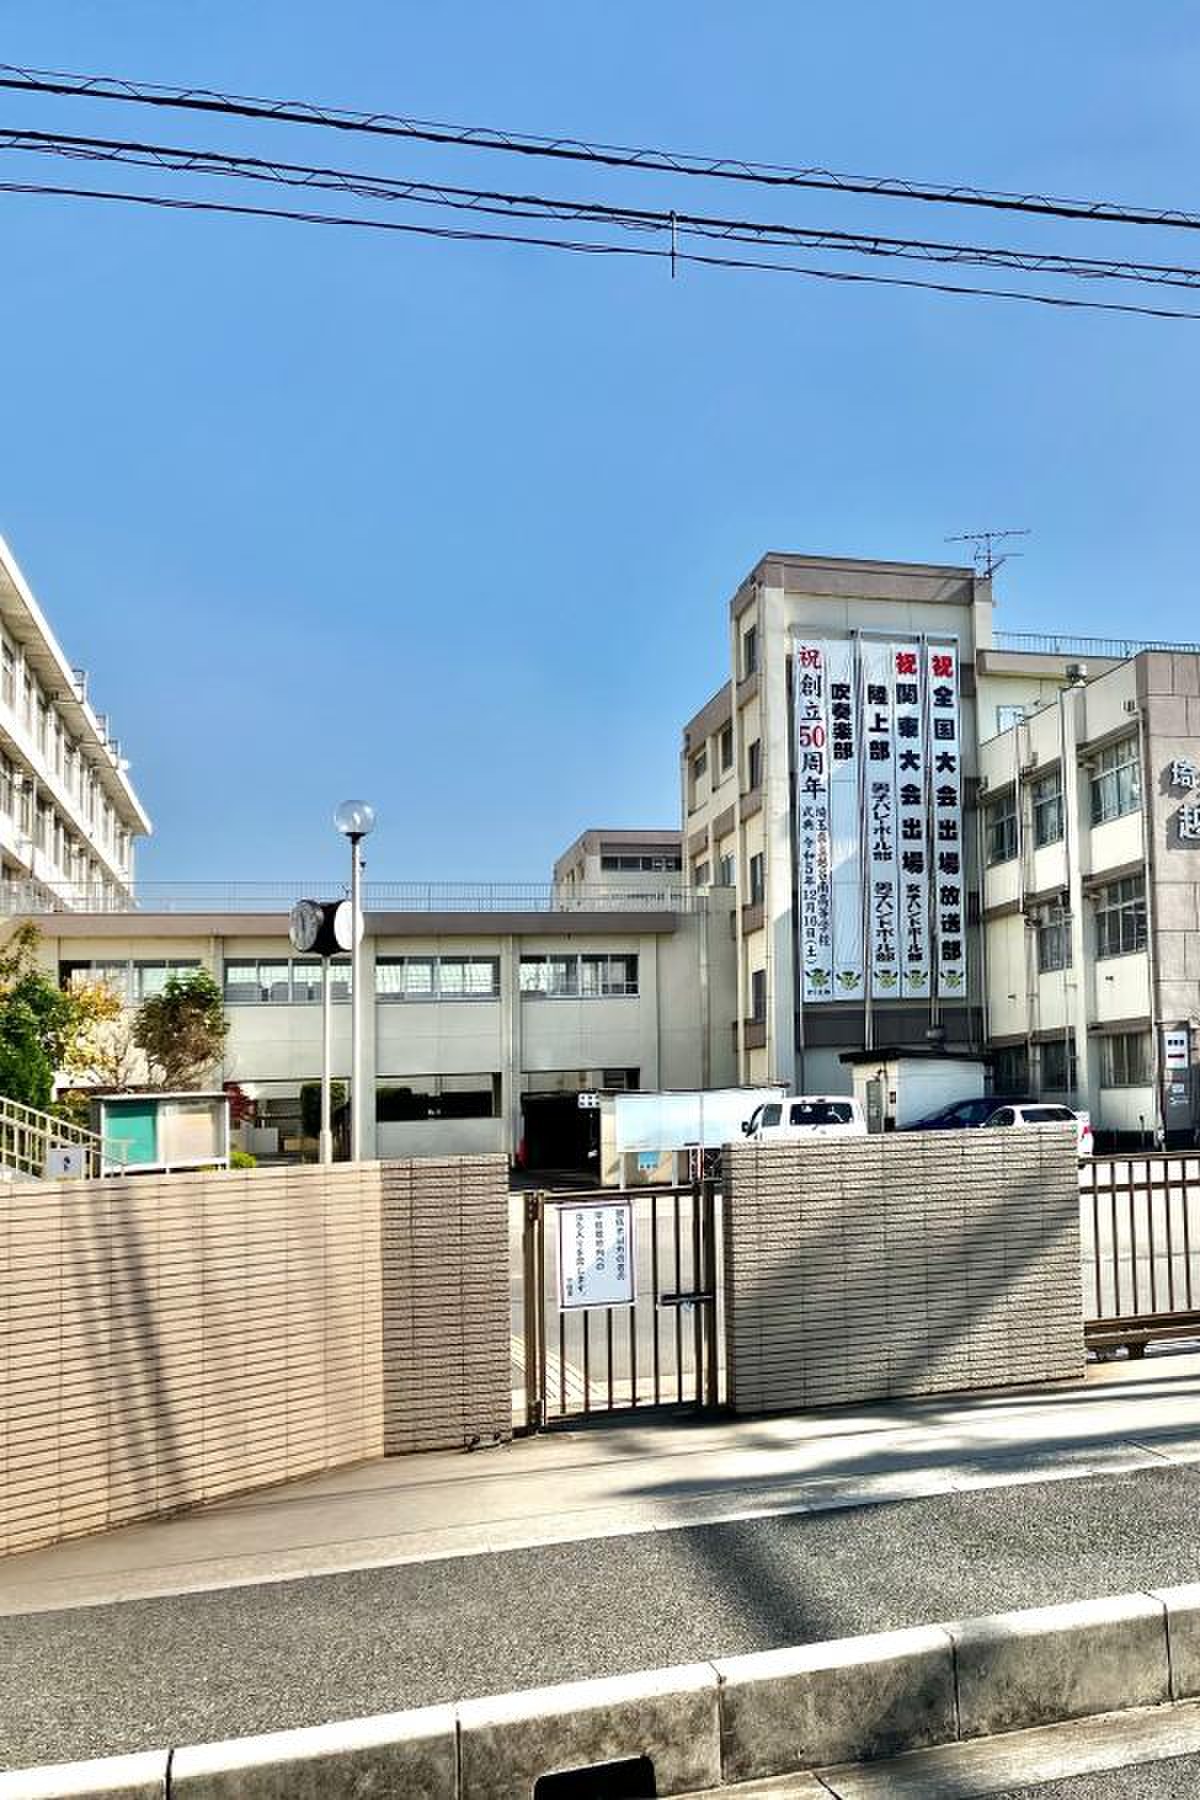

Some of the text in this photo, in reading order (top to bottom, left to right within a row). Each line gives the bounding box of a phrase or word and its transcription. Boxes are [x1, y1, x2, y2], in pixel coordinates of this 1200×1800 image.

[831, 683, 853, 760] 吹奏楽部
[867, 684, 890, 761] 陸上部
